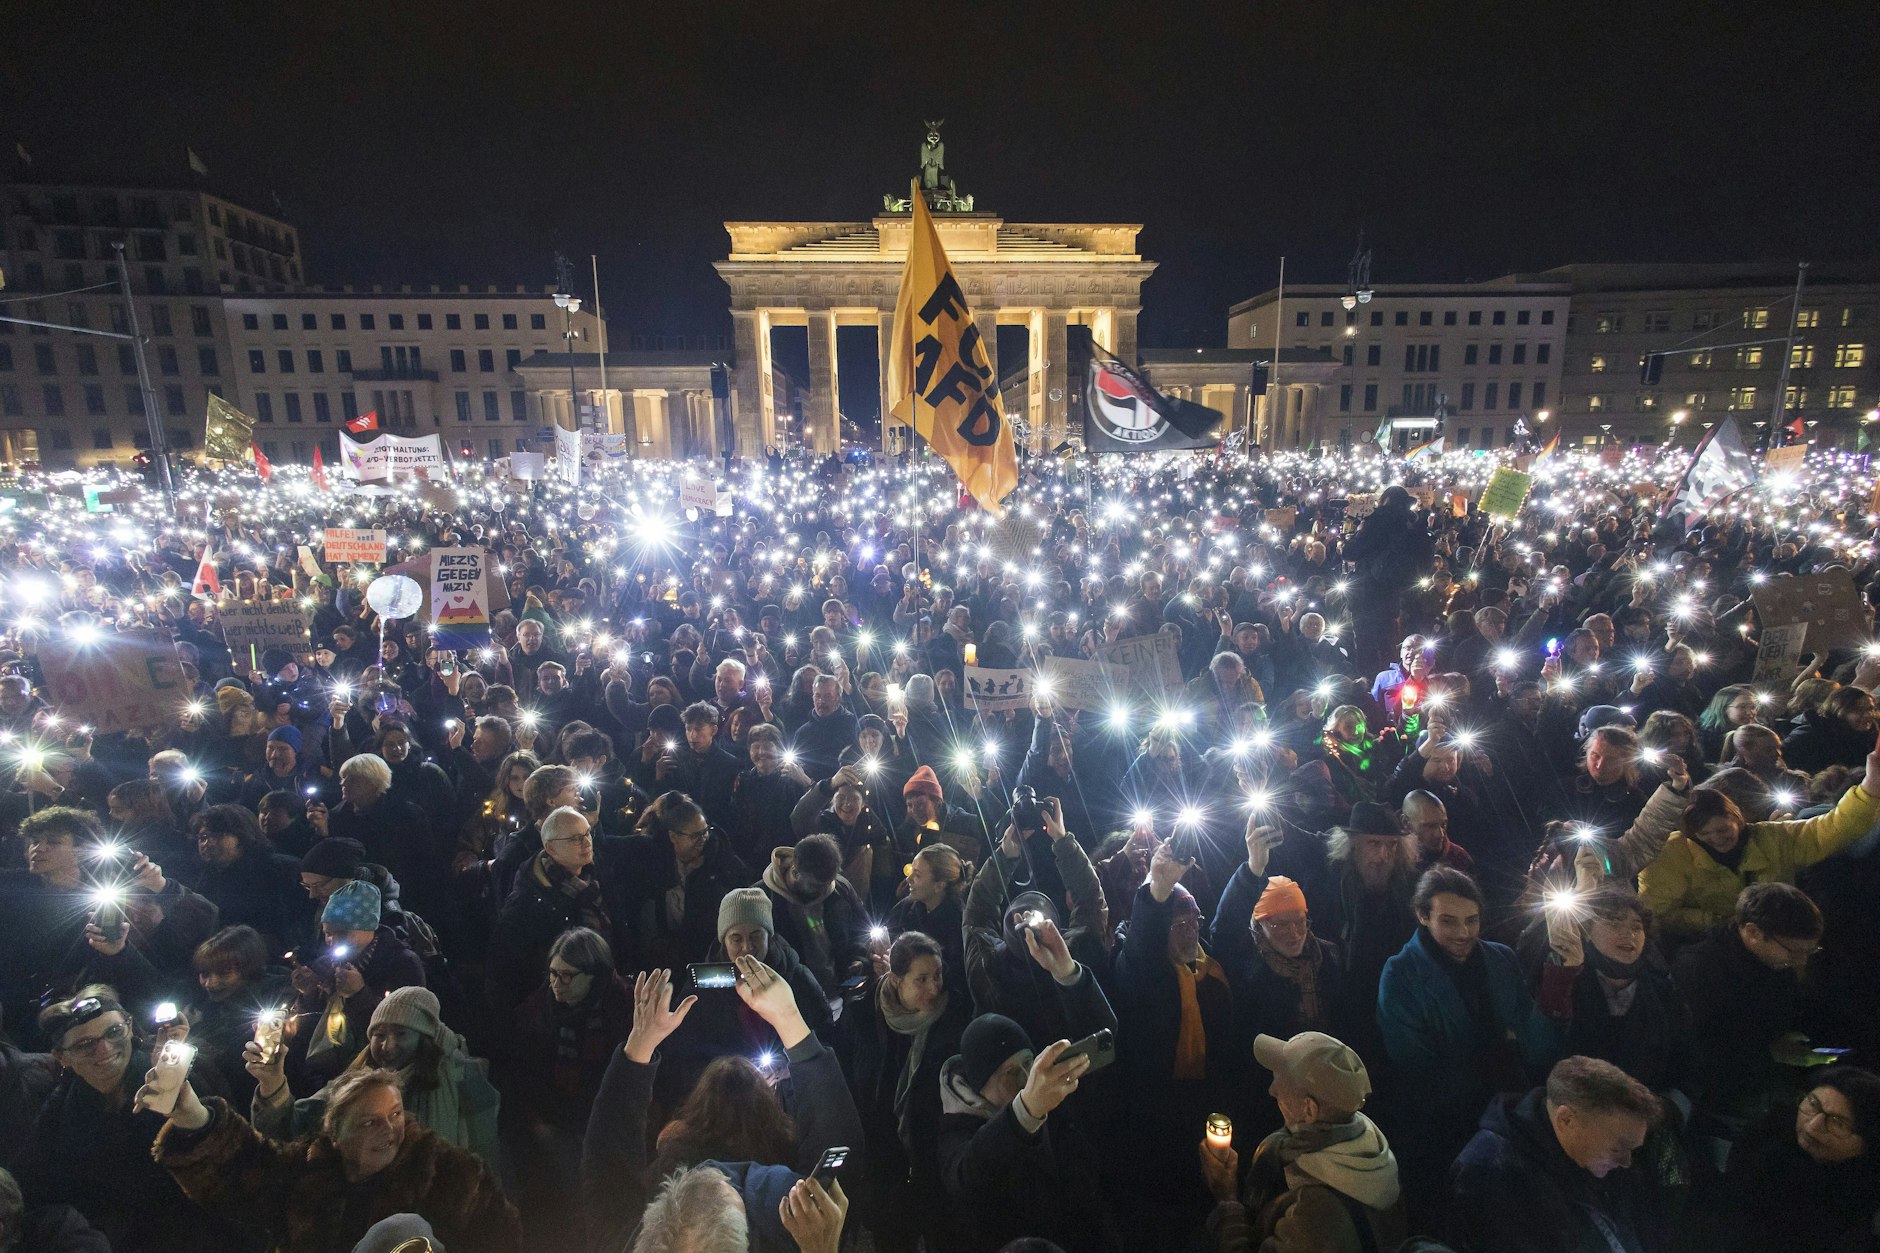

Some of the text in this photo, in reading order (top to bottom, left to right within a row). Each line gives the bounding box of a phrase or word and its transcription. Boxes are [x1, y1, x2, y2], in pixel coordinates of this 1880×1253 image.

[1112, 426, 1158, 439] AKTION
[325, 529, 355, 539] HILFE!
[325, 541, 386, 551] DEUTSCHLAND
[326, 552, 380, 562] HAT DEMENZ
[440, 554, 479, 567] MIEZIS
[437, 568, 482, 582] GEGEN
[442, 581, 473, 592] NAZIS
